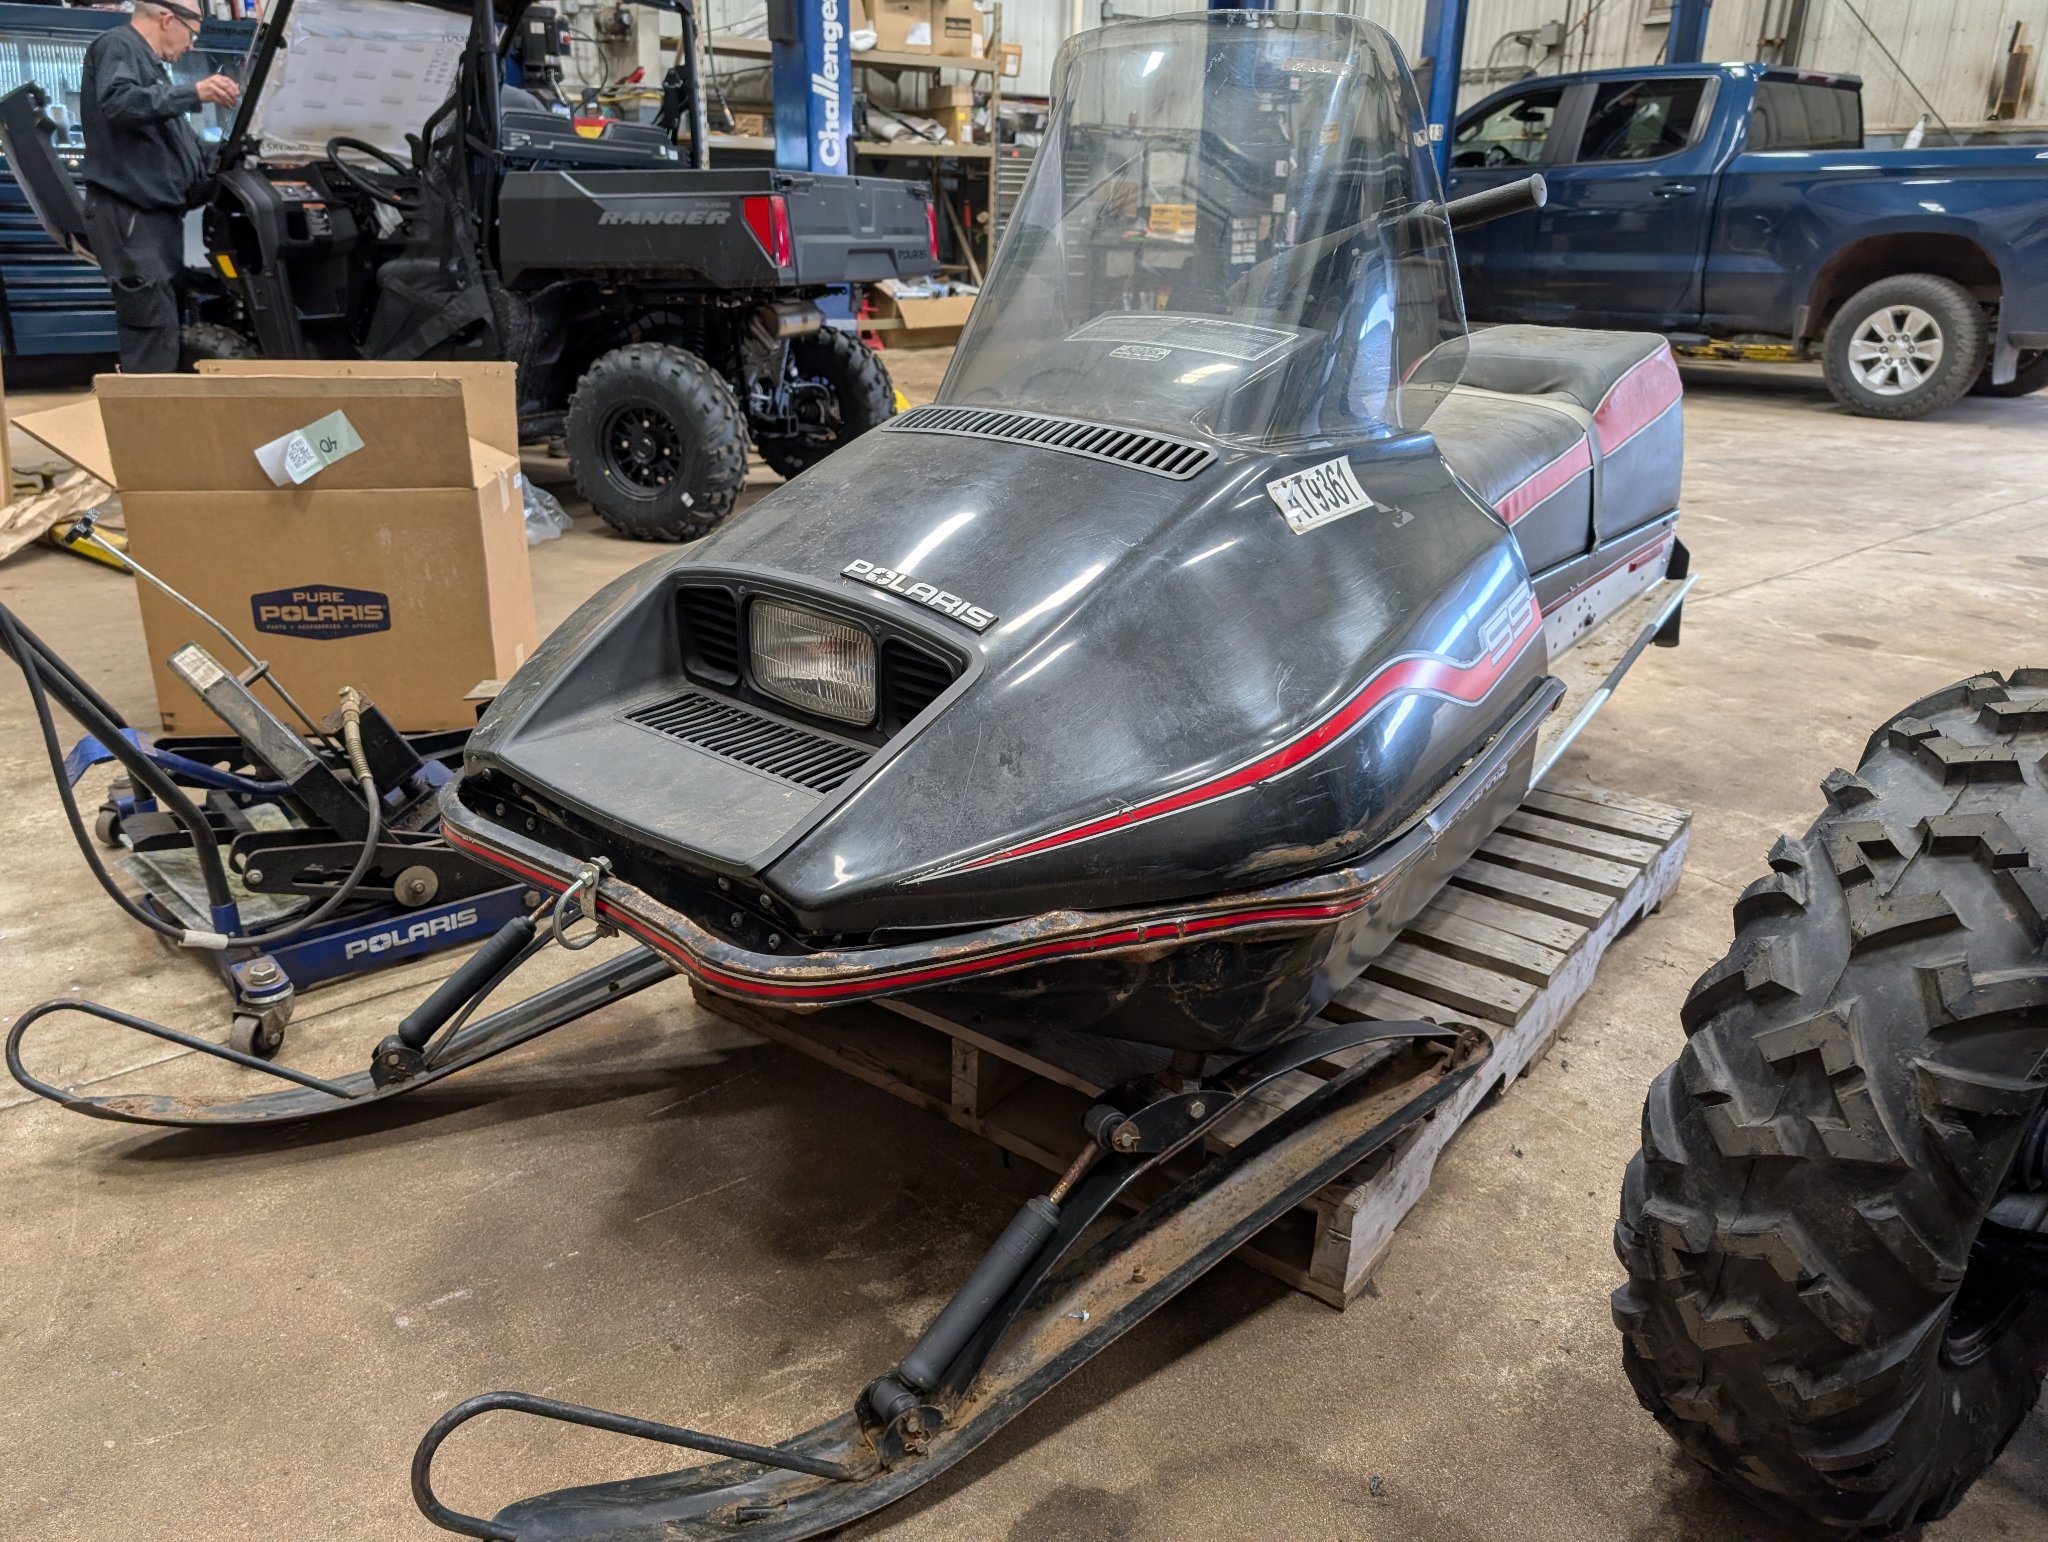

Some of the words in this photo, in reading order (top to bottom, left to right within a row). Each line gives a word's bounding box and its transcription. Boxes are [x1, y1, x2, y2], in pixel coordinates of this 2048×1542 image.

[811, 0, 843, 167] Challenge
[598, 210, 731, 225] RANGER
[292, 592, 344, 602] PURE
[843, 558, 994, 628] POLARIS
[260, 604, 384, 622] POLARIS
[345, 907, 478, 960] POLARIS
